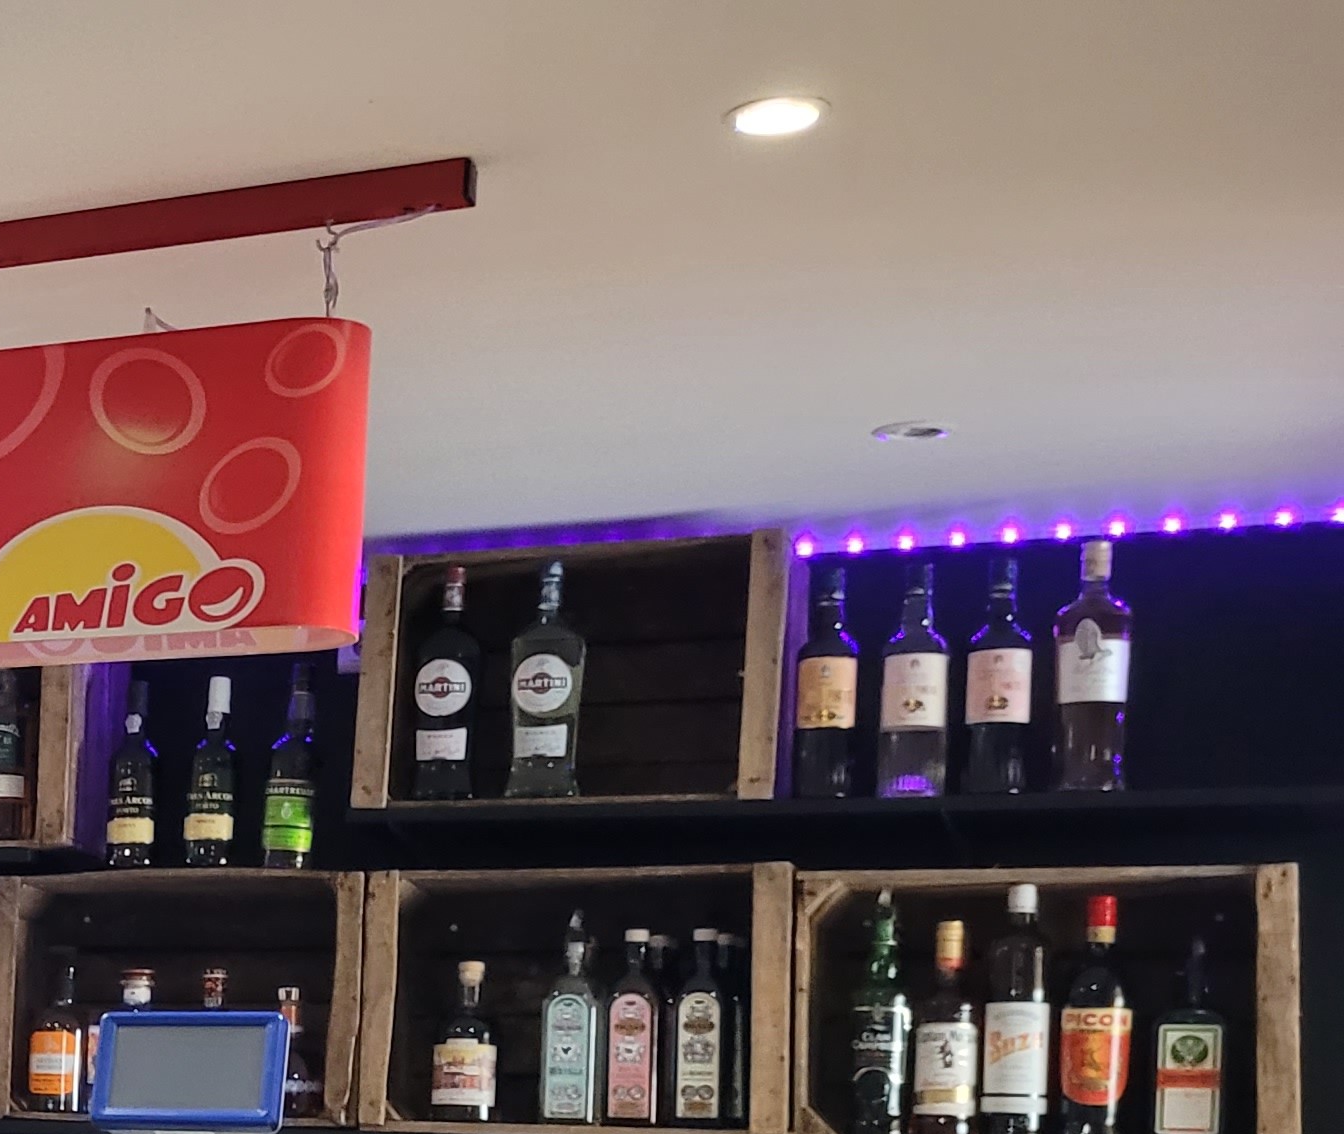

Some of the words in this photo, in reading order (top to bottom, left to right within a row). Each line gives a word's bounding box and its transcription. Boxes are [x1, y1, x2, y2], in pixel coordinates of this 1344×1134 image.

[12, 563, 255, 634] AMIGO
[420, 683, 464, 693] MARTINI
[519, 678, 566, 689] MARTINI
